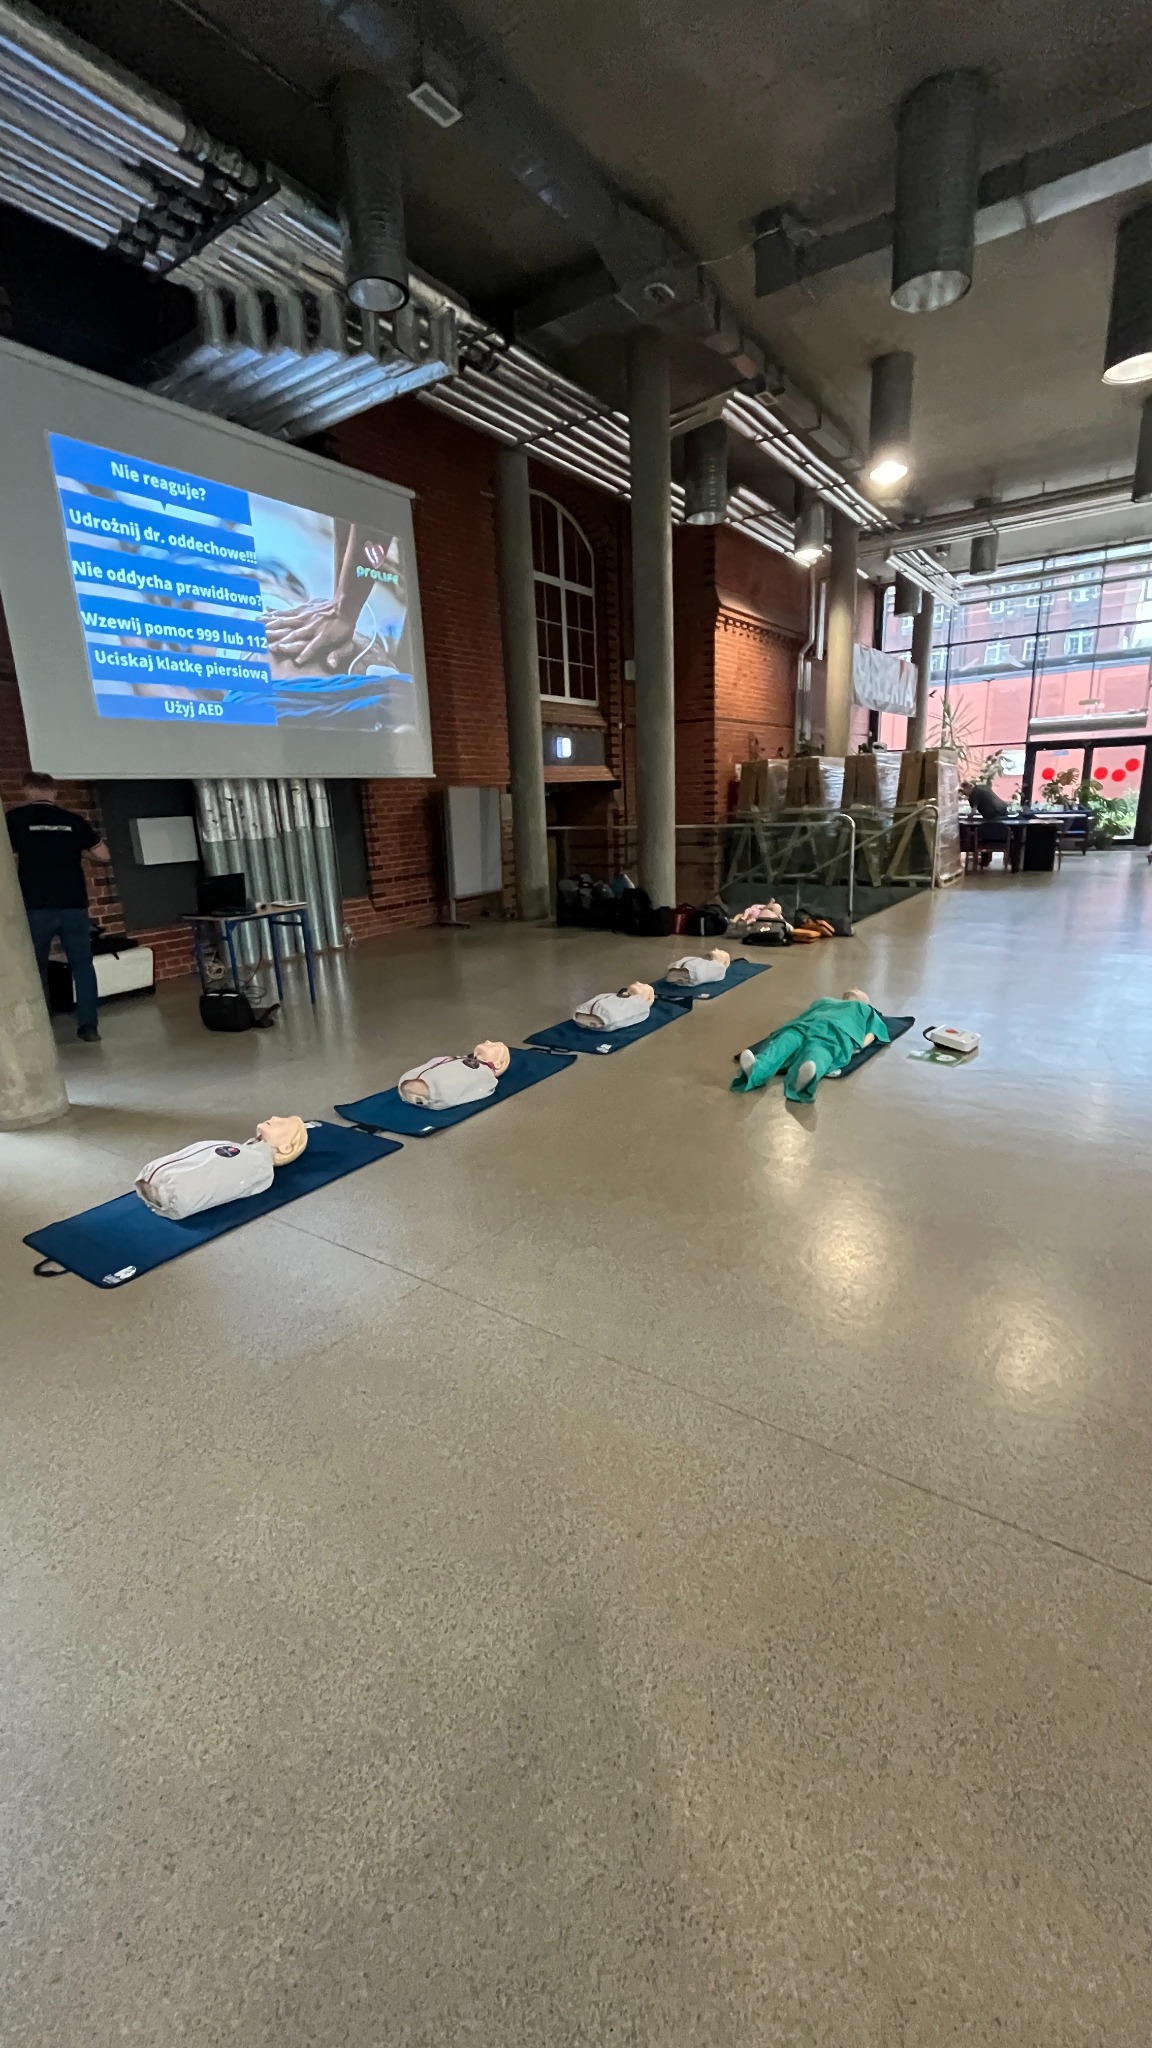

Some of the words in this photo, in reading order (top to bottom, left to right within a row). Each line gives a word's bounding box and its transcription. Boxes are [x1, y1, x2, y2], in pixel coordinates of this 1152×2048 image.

[110, 461, 140, 482] Nie
[143, 473, 206, 501] reaguje?
[68, 508, 140, 541] Udrożnij
[143, 526, 165, 543] dr.
[168, 534, 257, 565] oddechowe!!!
[72, 560, 103, 578] Nie
[106, 568, 173, 591] oddycha
[175, 582, 262, 607] prawidłowo?
[80, 610, 141, 635] Wzewij
[144, 622, 194, 639] pomoc
[196, 627, 220, 643] 999
[222, 631, 244, 646] lub
[246, 635, 268, 649] 112
[94, 650, 154, 672] Uciskaj
[155, 655, 203, 677] klatkę
[205, 662, 269, 683] piersiową
[164, 700, 195, 718] Użyj
[198, 704, 224, 717] AED
